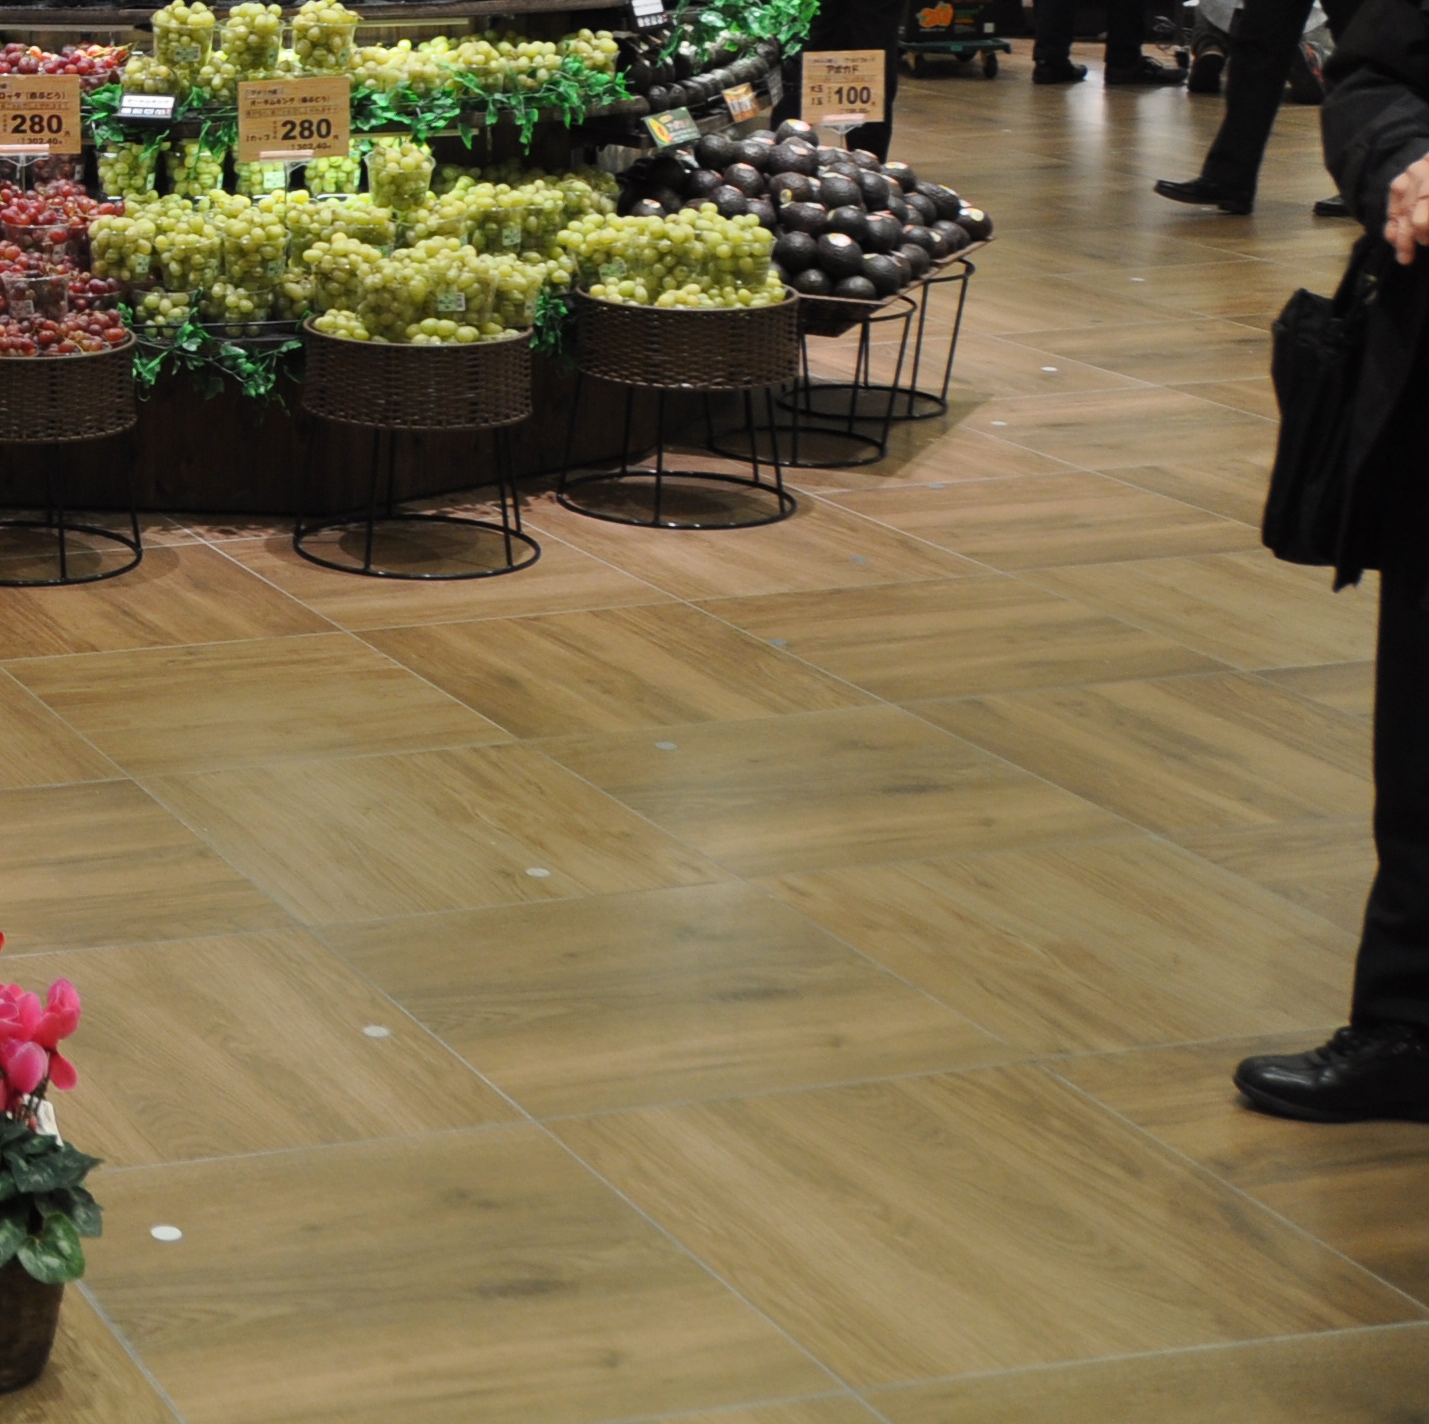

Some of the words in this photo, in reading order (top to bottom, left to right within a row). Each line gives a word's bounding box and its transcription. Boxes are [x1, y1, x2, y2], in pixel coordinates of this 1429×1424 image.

[826, 64, 859, 74] アボカド
[834, 86, 872, 105] 100
[11, 114, 63, 134] 280
[281, 118, 332, 141] 280
